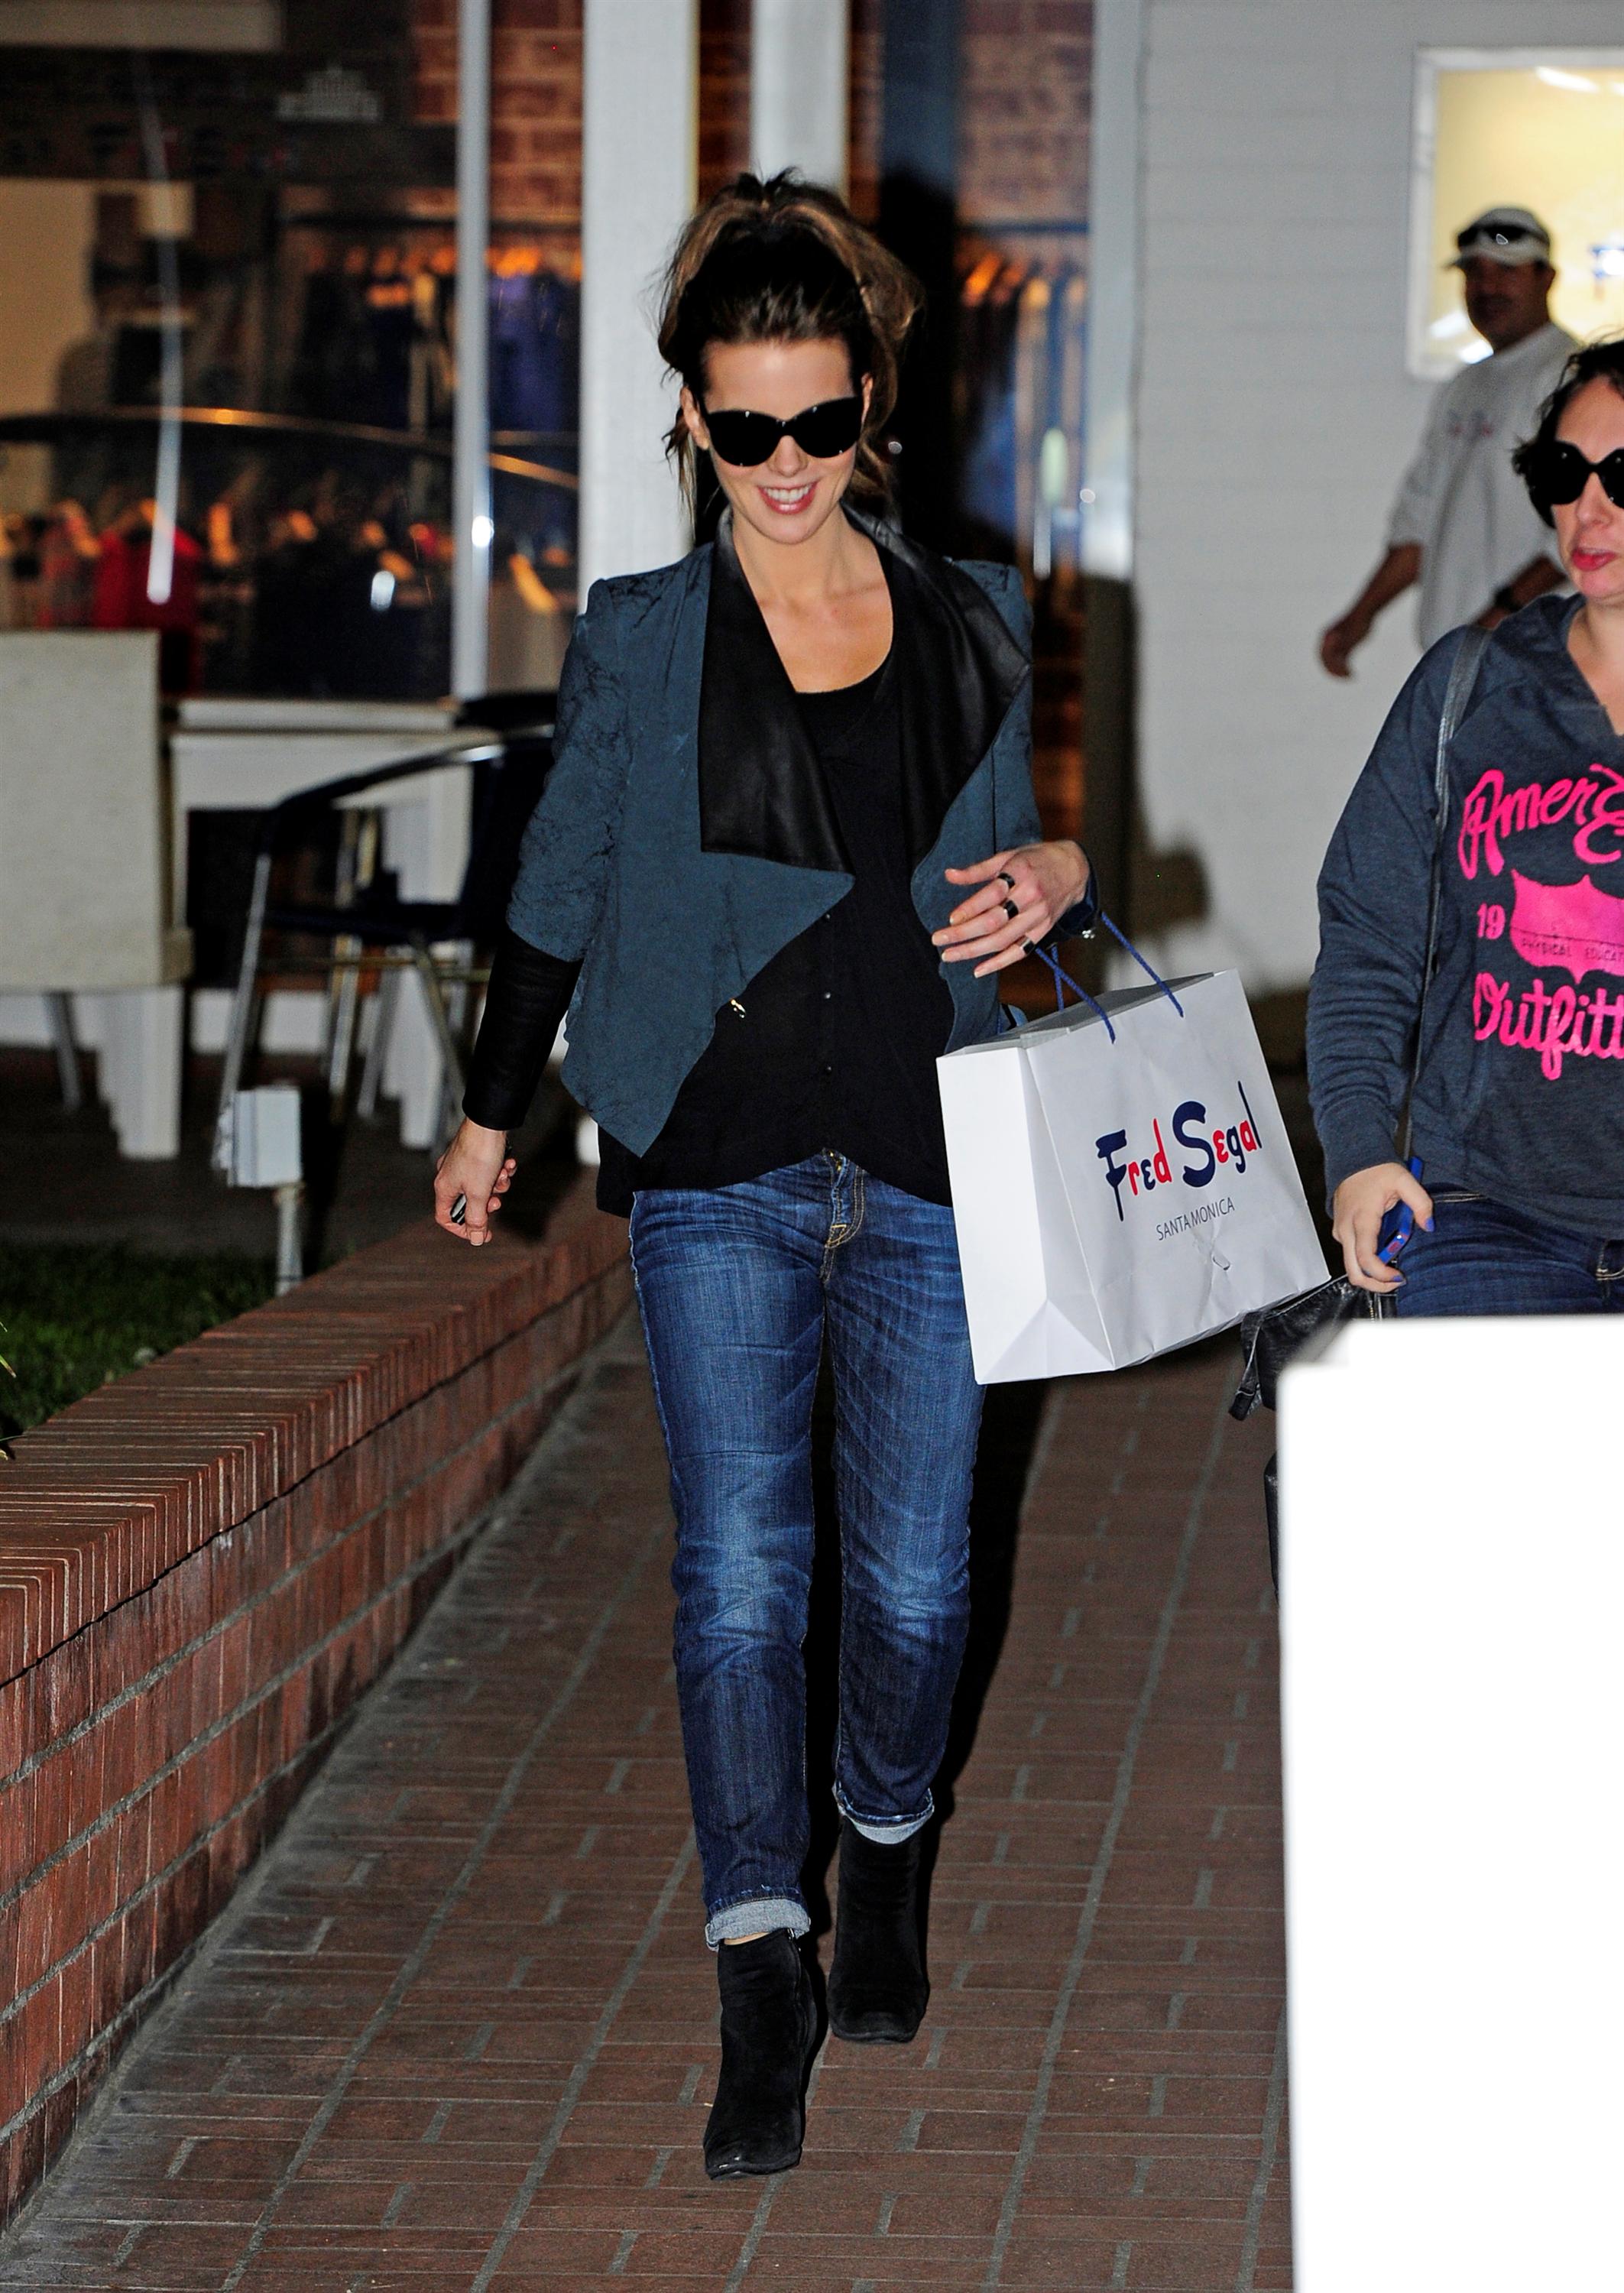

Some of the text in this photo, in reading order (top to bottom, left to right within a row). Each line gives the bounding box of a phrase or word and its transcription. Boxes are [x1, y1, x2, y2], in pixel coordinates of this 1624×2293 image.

[1477, 903, 1506, 940] 19
[1095, 1080, 1263, 1222] Fred Segal
[1156, 1196, 1235, 1241] SANTA MONICA
